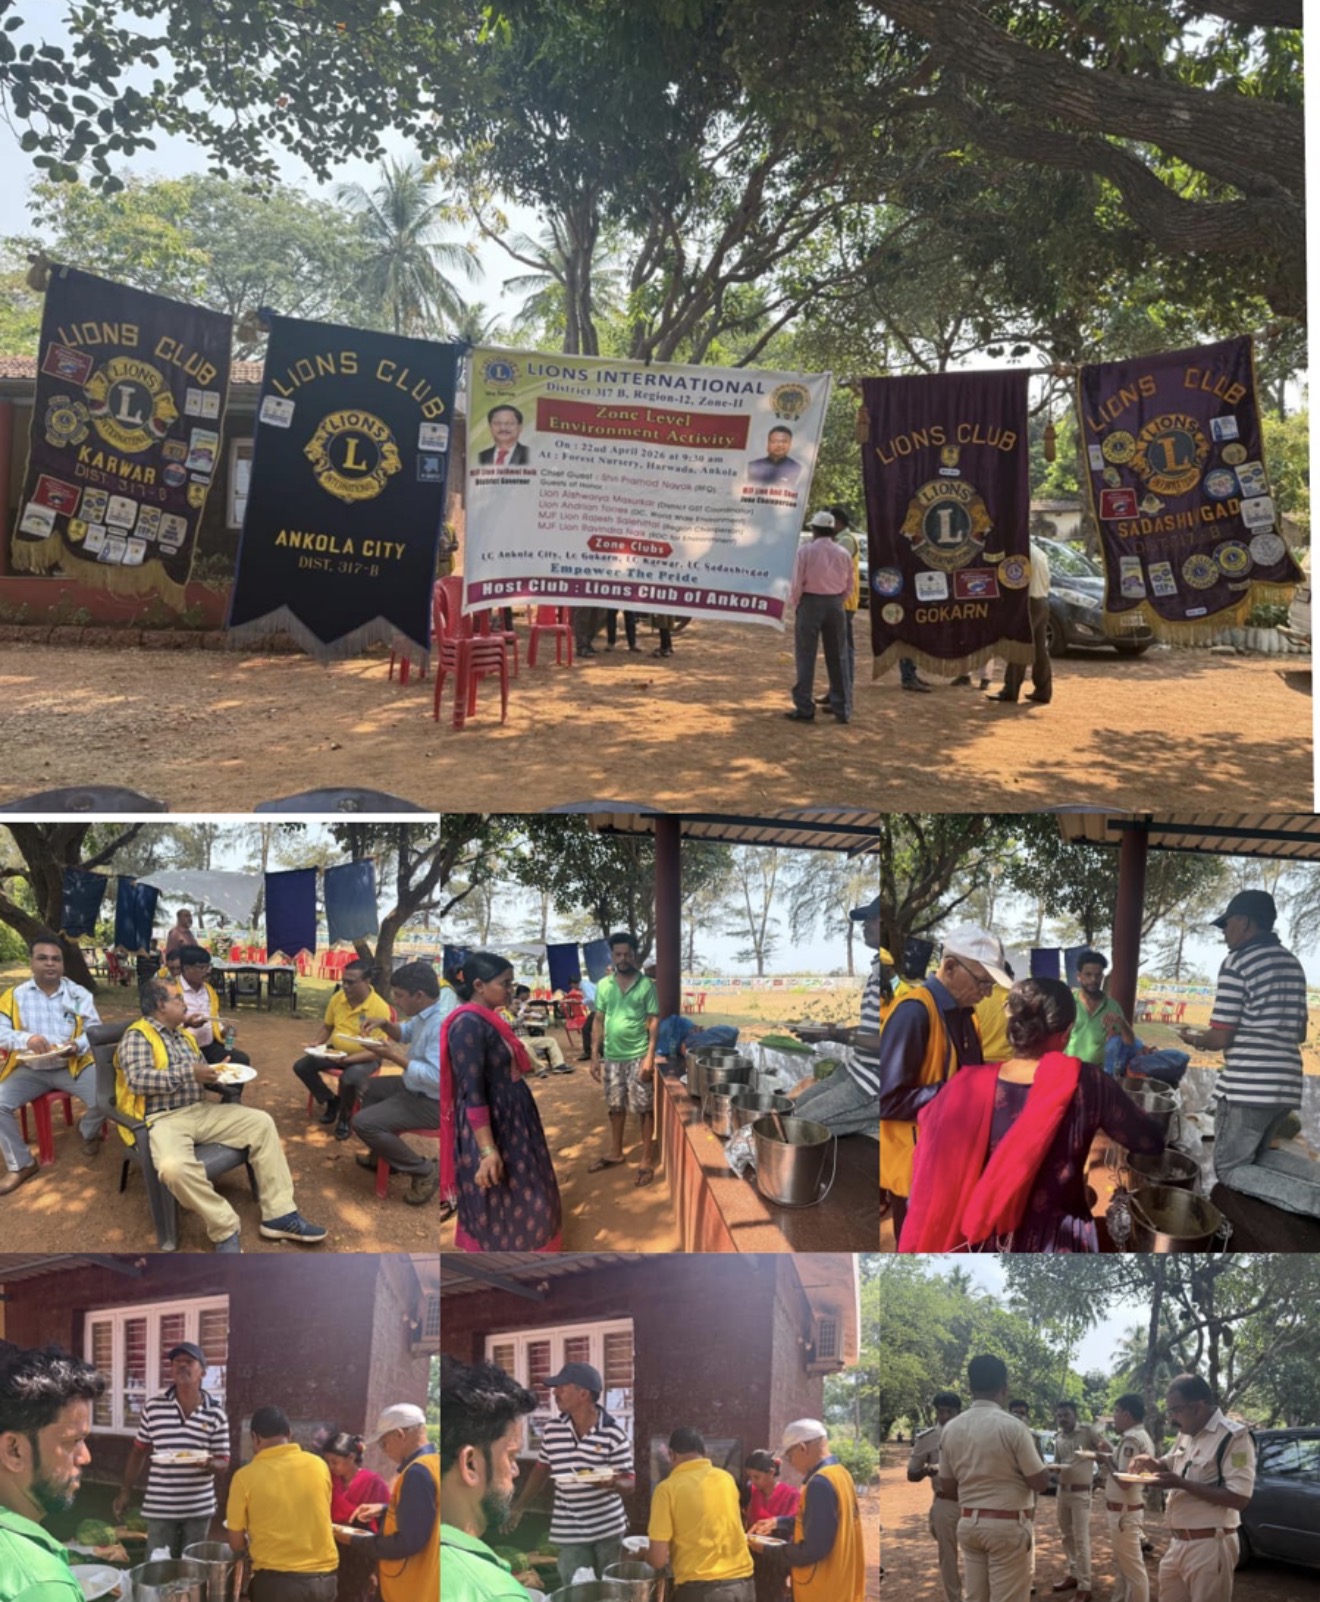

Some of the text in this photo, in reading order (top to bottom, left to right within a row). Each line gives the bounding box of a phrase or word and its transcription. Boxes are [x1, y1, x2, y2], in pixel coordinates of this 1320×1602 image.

[58, 321, 217, 385] LIONS CLUB
[112, 363, 158, 388] LIONS
[272, 351, 359, 397] LIONS
[376, 359, 445, 418] CLUB
[527, 362, 588, 381] LIONS
[596, 369, 765, 395] INTERNATIONAL
[116, 385, 143, 424] L
[546, 382, 592, 396] District
[595, 388, 613, 398] 317
[633, 388, 694, 406] Region-12,
[1087, 375, 1156, 432] LIONS
[329, 413, 387, 438] LIONS
[595, 406, 691, 427] Zone Level
[1143, 416, 1198, 438] LIONS
[549, 416, 734, 449] Environment Activity
[875, 423, 1017, 465] LIONS CLUB
[342, 437, 368, 470] L
[554, 439, 571, 449] On
[581, 443, 607, 454] 22nd
[609, 446, 638, 456] April
[640, 449, 666, 460] 2026
[669, 453, 679, 461] at
[1156, 437, 1191, 472] L
[78, 445, 156, 485] KARWAR
[538, 450, 551, 459] At
[561, 452, 595, 464] Forest
[598, 456, 643, 470] Nursery,
[646, 460, 697, 475] Harwada,
[701, 466, 738, 477] Ankola
[540, 468, 564, 478] Chief
[566, 470, 592, 480] Guest
[620, 475, 659, 488] Pramod
[661, 481, 693, 491] Nayak
[540, 478, 567, 488] Guests
[922, 482, 970, 502] LIONS
[538, 500, 559, 510] Lion
[539, 489, 559, 499] Lion
[537, 521, 556, 530] MJF
[558, 522, 578, 531] Lion
[538, 511, 557, 520] MJF
[559, 512, 580, 521] Lion
[936, 508, 963, 543] L
[1117, 498, 1241, 538] SADASHIGAD
[275, 529, 406, 559] ANKOLA CITY
[593, 538, 665, 555] Zone Clubs
[298, 555, 379, 577] DIST. 317-B
[481, 551, 495, 561] LC
[498, 550, 534, 559] Ankola
[537, 551, 561, 560] City,
[580, 552, 621, 563] Gokarn,
[687, 561, 701, 570] LC
[550, 562, 699, 584] Empower The Pride
[482, 580, 522, 596] Host
[527, 579, 569, 594] Club
[585, 582, 632, 598] Lions
[637, 585, 678, 602] Club
[683, 591, 702, 605] of
[705, 592, 768, 611] Ankola
[915, 603, 989, 623] GOKARN
